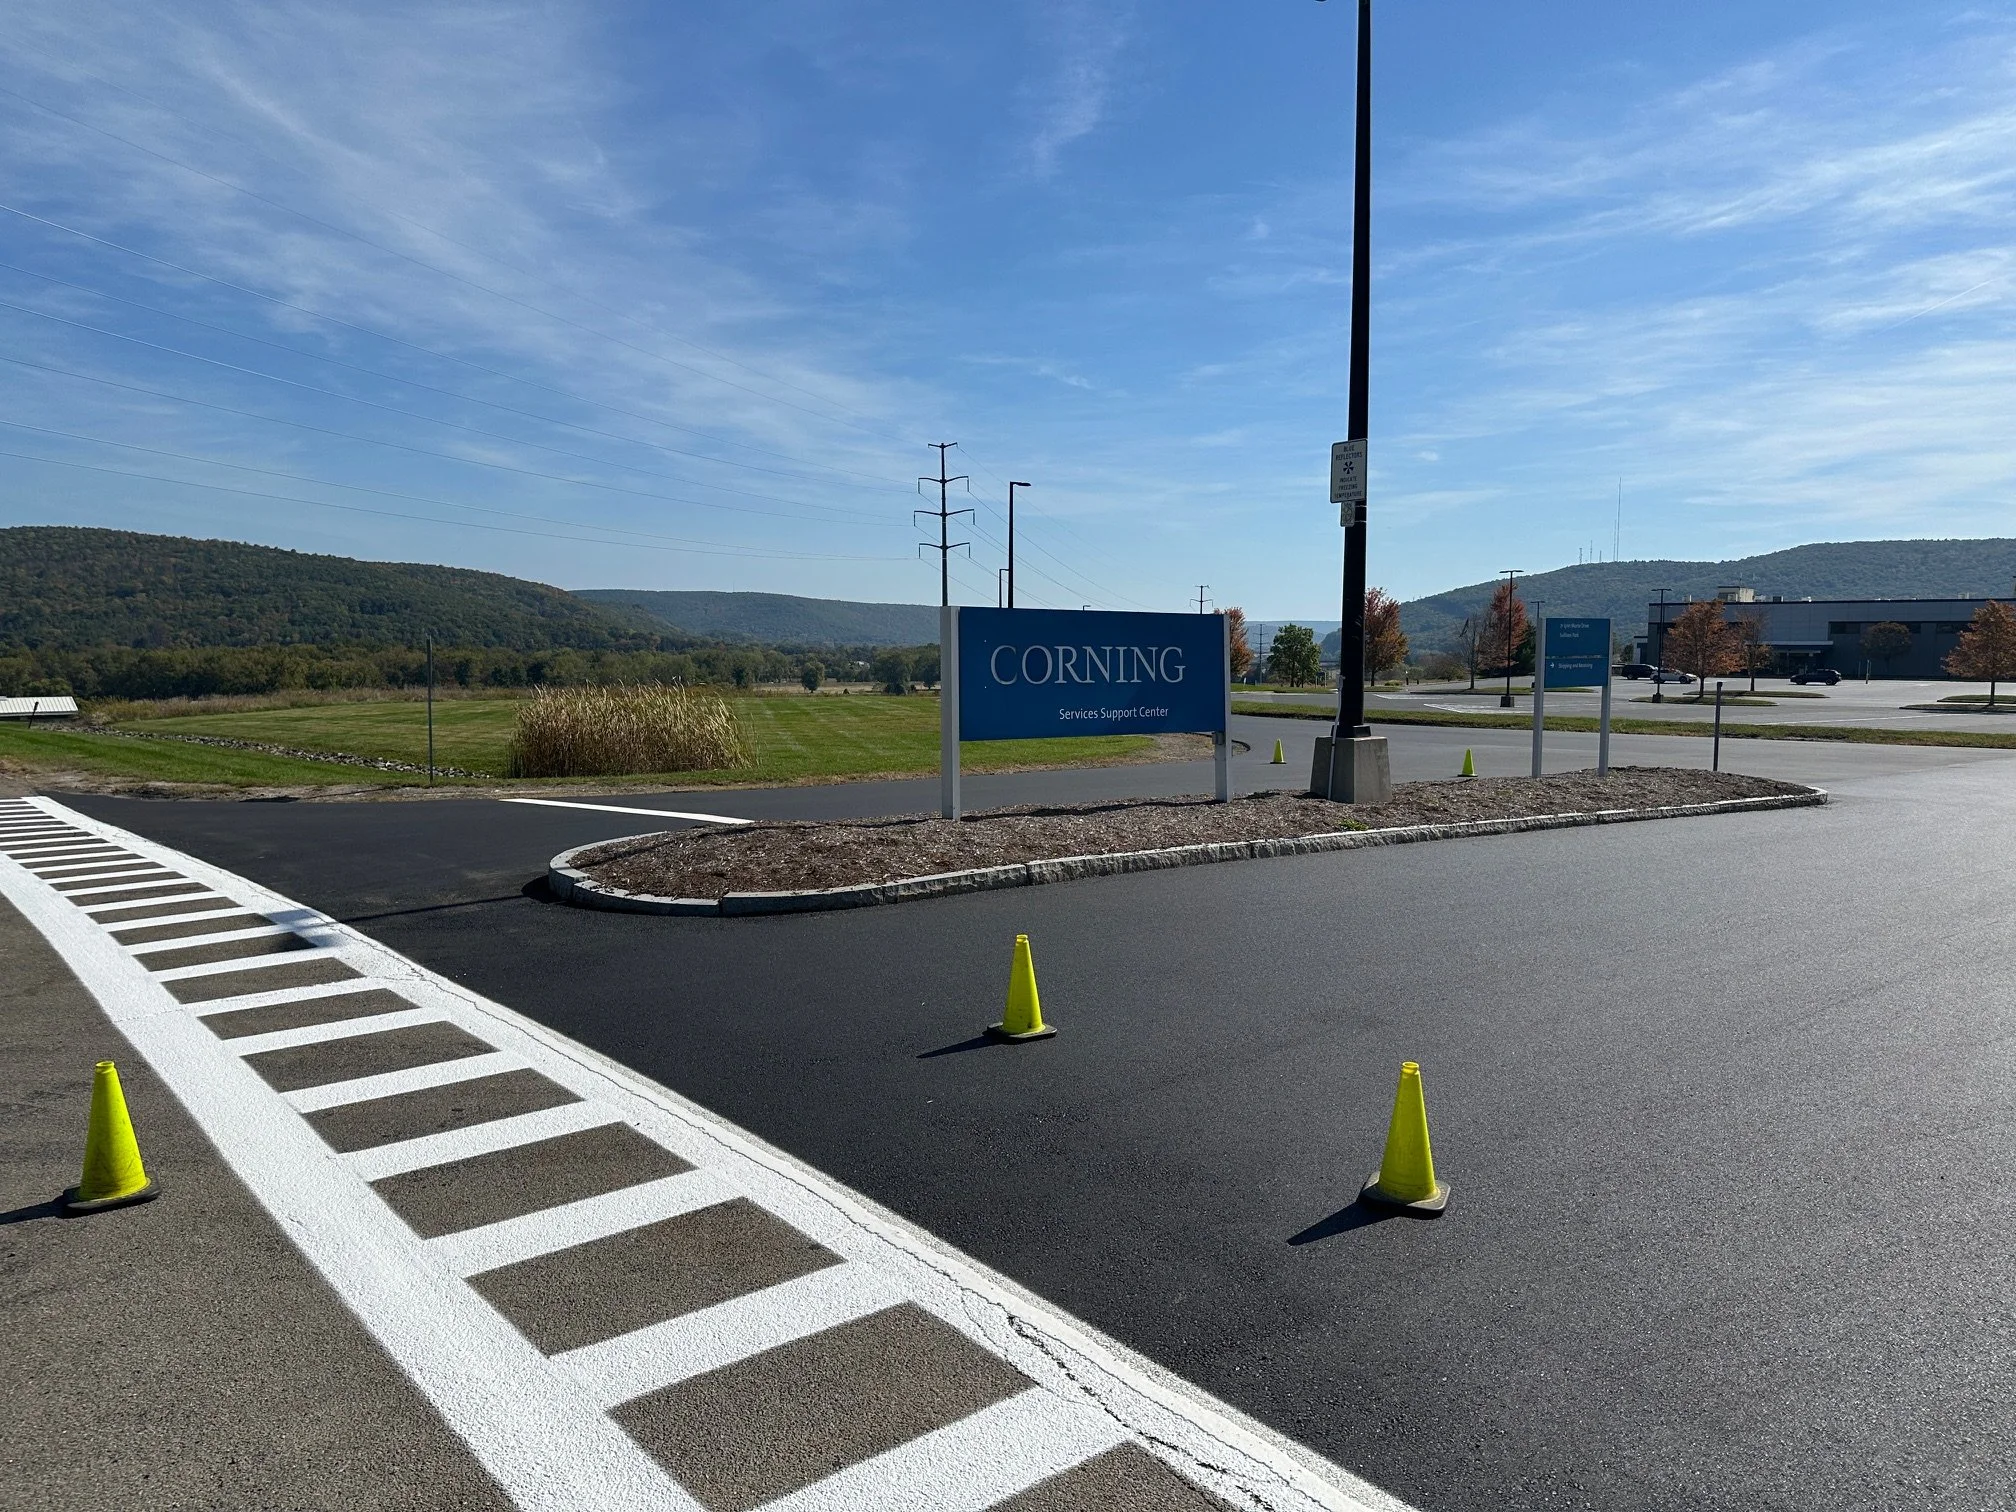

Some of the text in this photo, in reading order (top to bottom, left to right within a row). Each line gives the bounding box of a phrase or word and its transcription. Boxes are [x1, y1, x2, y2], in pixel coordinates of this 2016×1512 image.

[990, 645, 1186, 685] CORNING
[1059, 706, 1169, 721] Services Support Center
